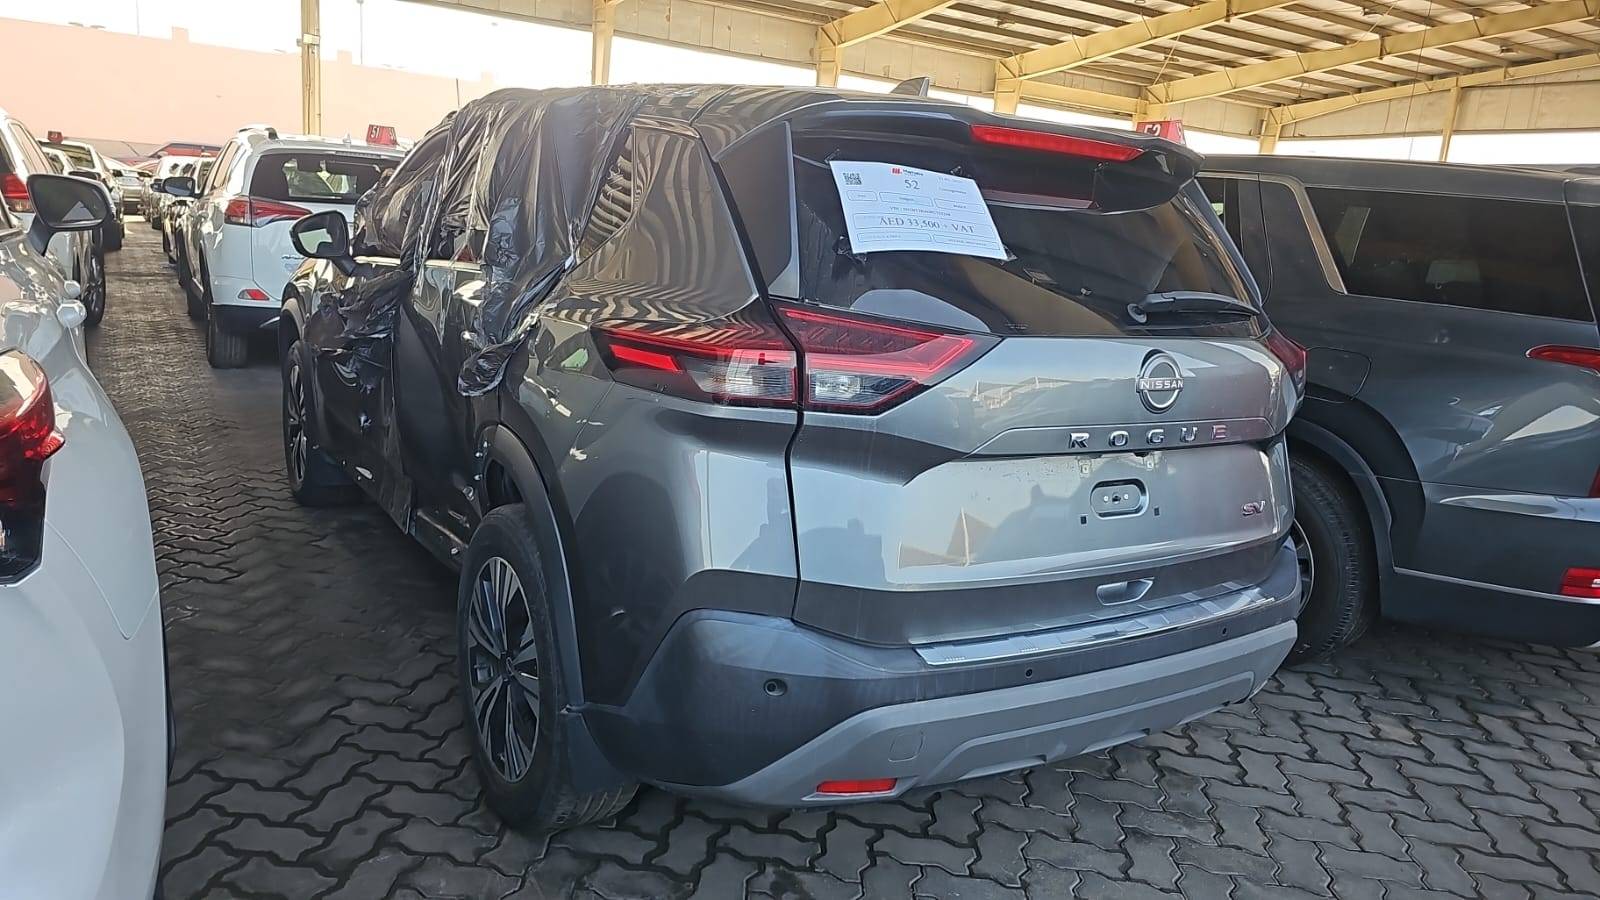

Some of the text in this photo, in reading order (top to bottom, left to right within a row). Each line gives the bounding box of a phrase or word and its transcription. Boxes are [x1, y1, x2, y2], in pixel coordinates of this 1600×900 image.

[904, 179, 920, 190] 52
[879, 217, 905, 225] AED
[906, 218, 940, 229] 33,500
[951, 224, 976, 234] VAT
[1140, 379, 1184, 391] NISSAN
[1069, 425, 1227, 448] ROGUE
[1242, 500, 1266, 516] SV
